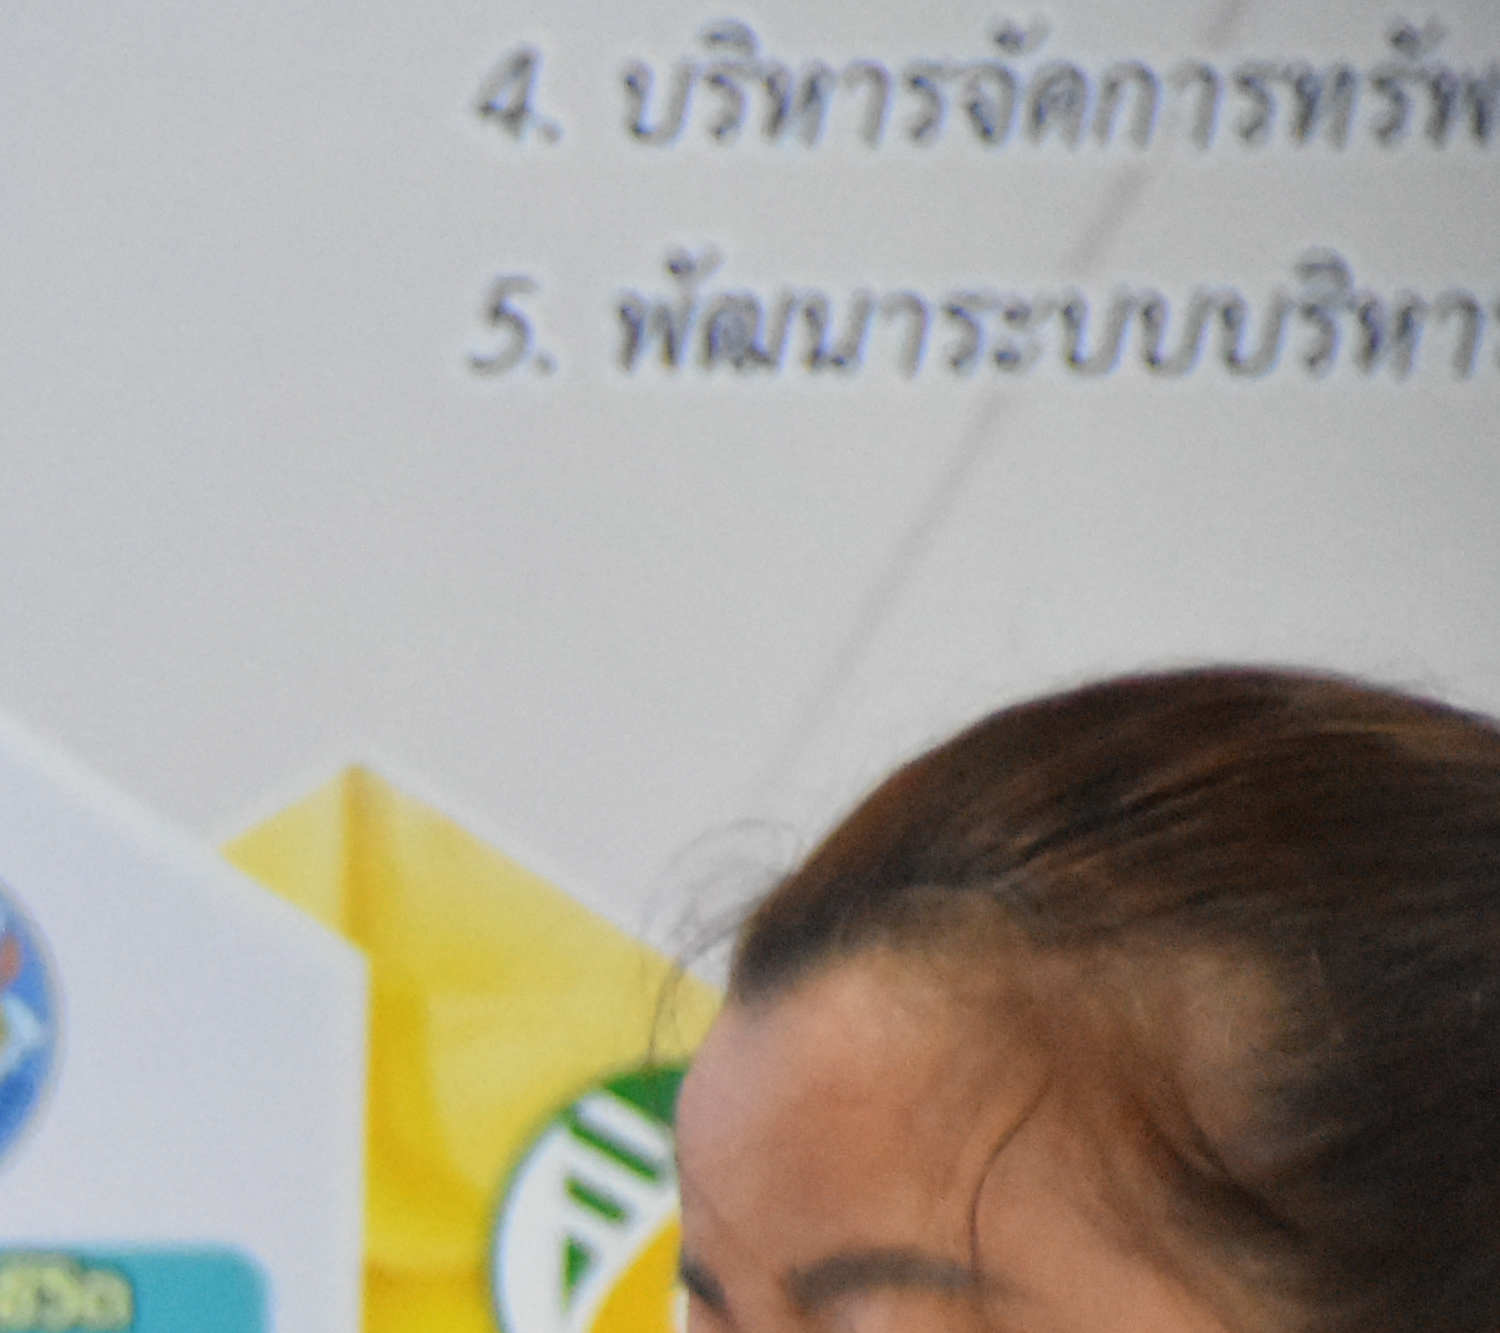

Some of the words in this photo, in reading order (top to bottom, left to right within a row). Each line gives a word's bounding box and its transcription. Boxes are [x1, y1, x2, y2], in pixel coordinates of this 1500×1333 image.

[475, 42, 563, 145] 4.
[467, 276, 557, 378] 5.
[616, 243, 1500, 380] พัฒนาระบบบริหา
